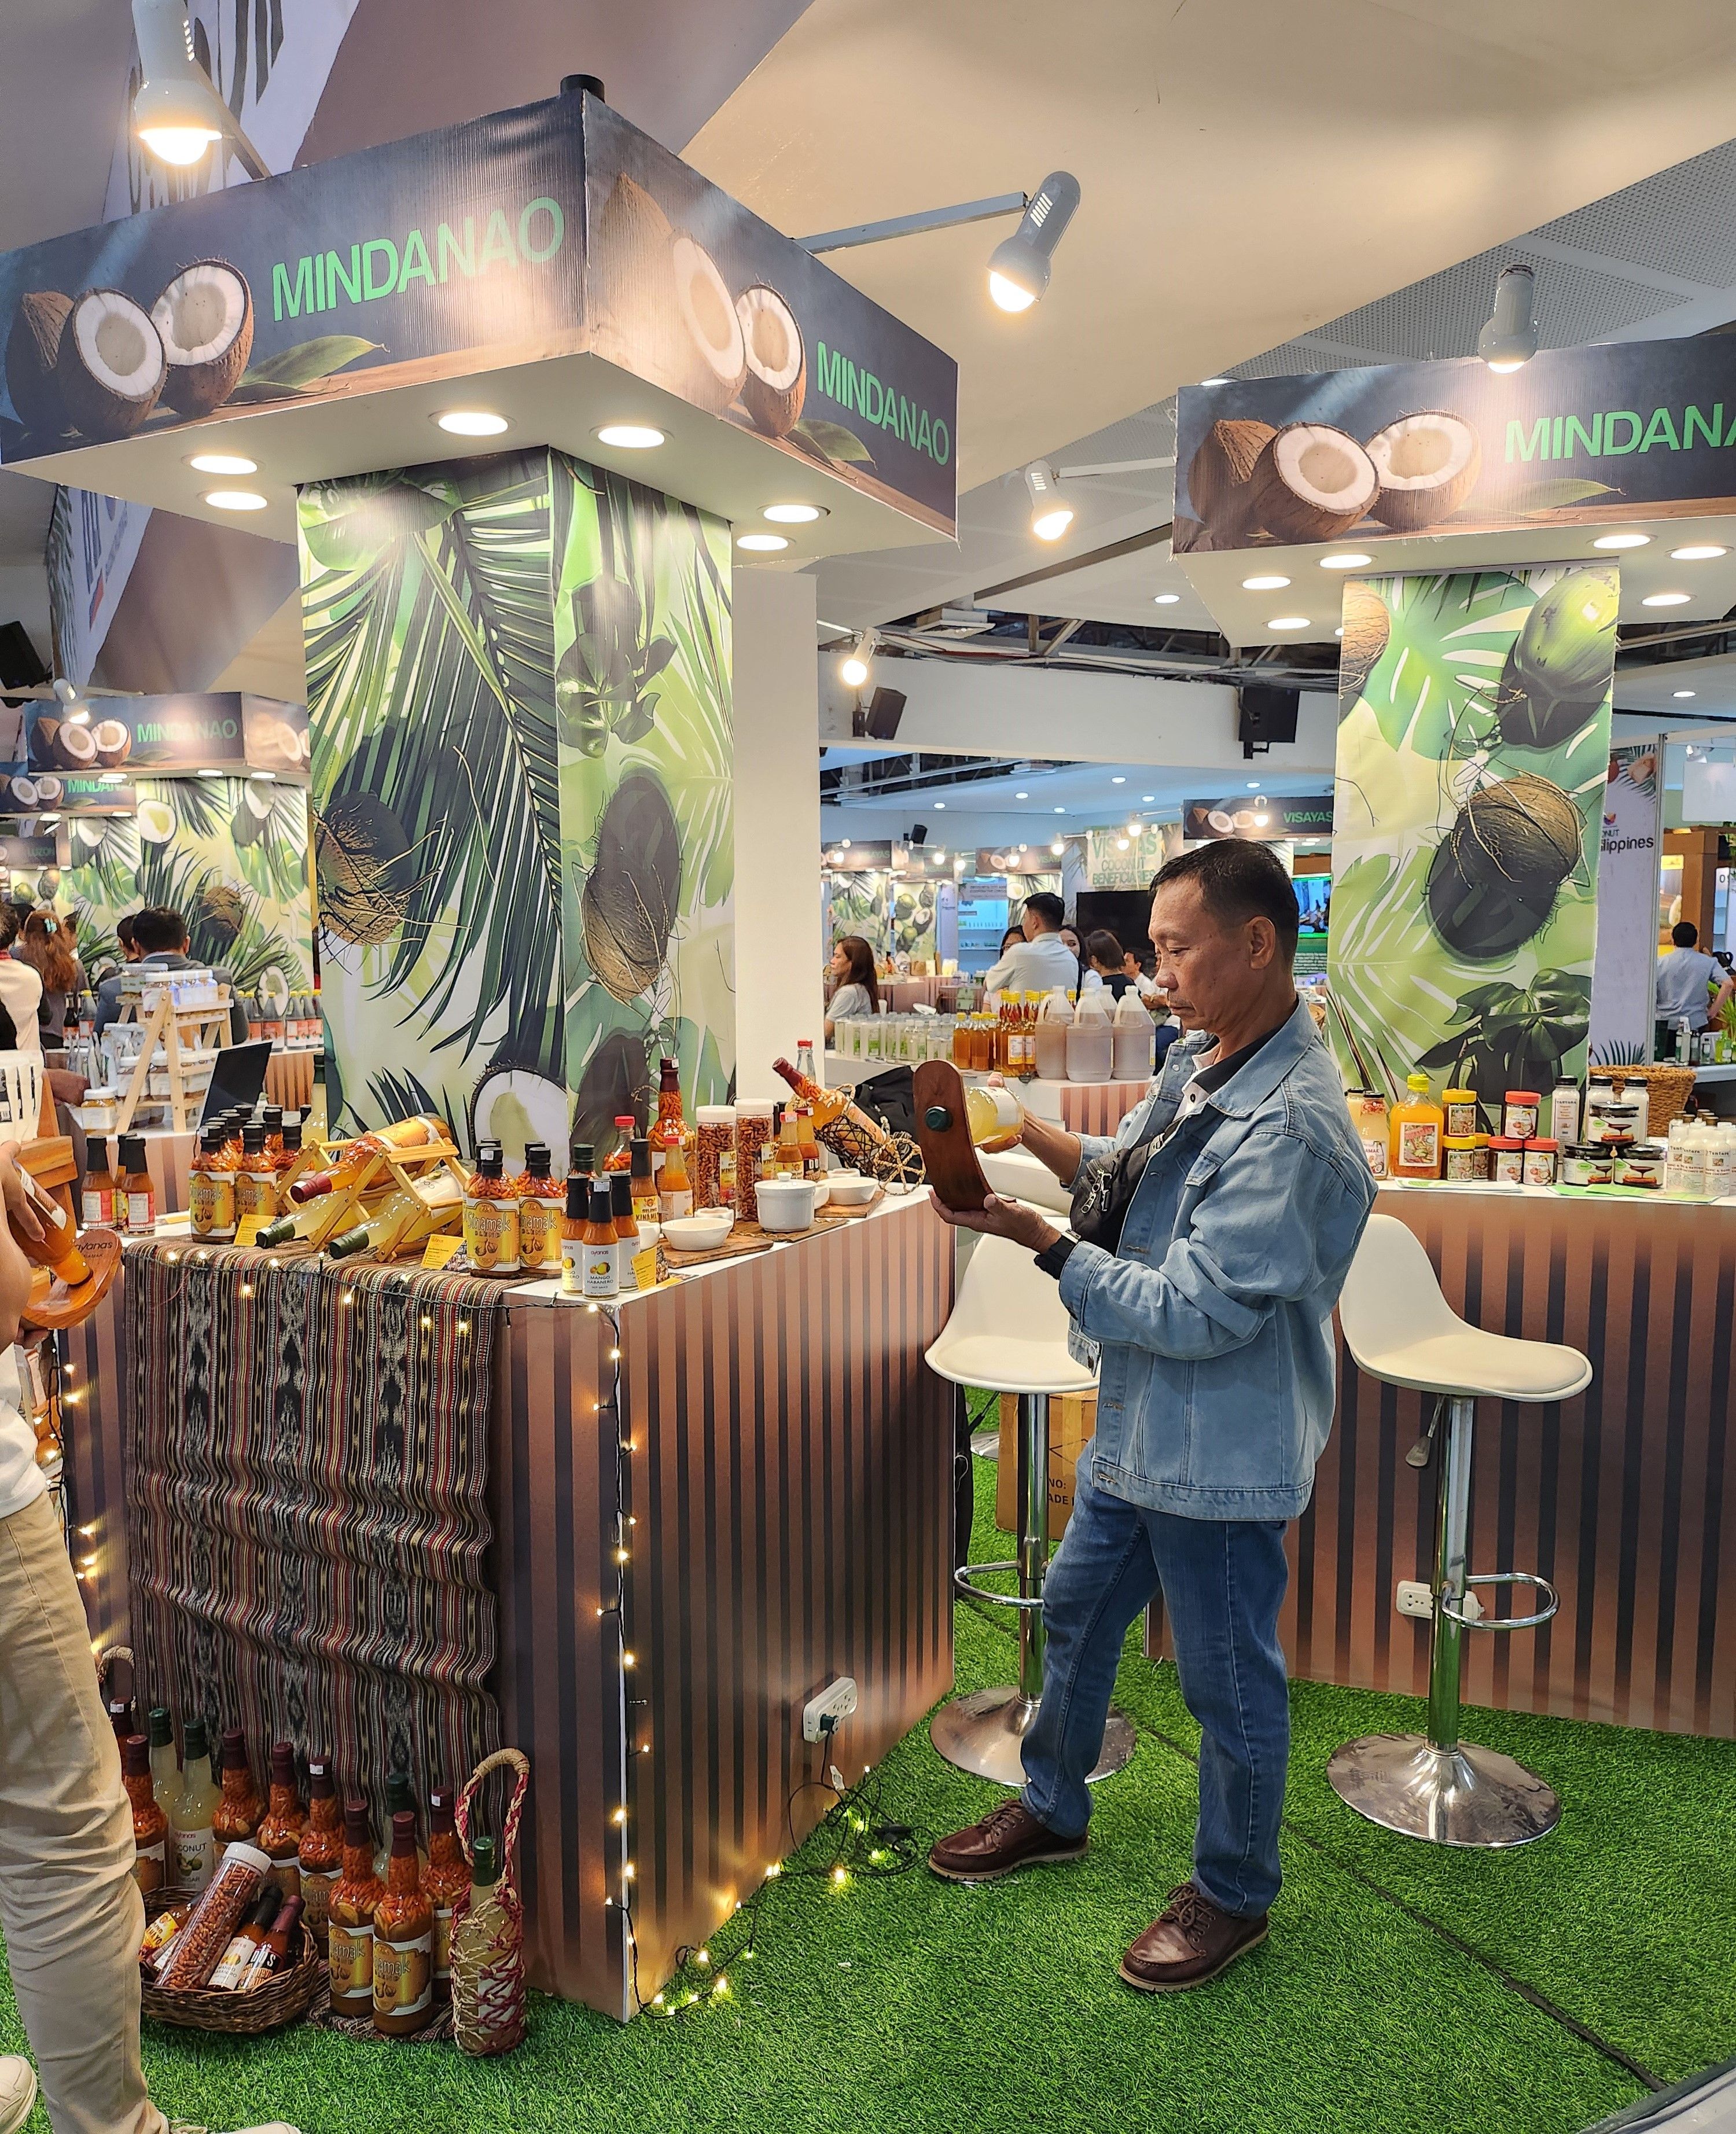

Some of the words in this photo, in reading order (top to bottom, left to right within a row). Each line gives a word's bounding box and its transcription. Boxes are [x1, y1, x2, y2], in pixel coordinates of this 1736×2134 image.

[272, 197, 565, 322] MINDANAO
[817, 340, 950, 466] MINDANAO
[137, 719, 238, 743] MINDANAO
[1283, 812, 1332, 823] VISAYAS
[1601, 837, 1654, 854] ilippines
[468, 1211, 512, 1233] Sinamak
[521, 1209, 557, 1231] namak
[1049, 1478, 1066, 1489] NO:
[1048, 1497, 1069, 1505] ADE
